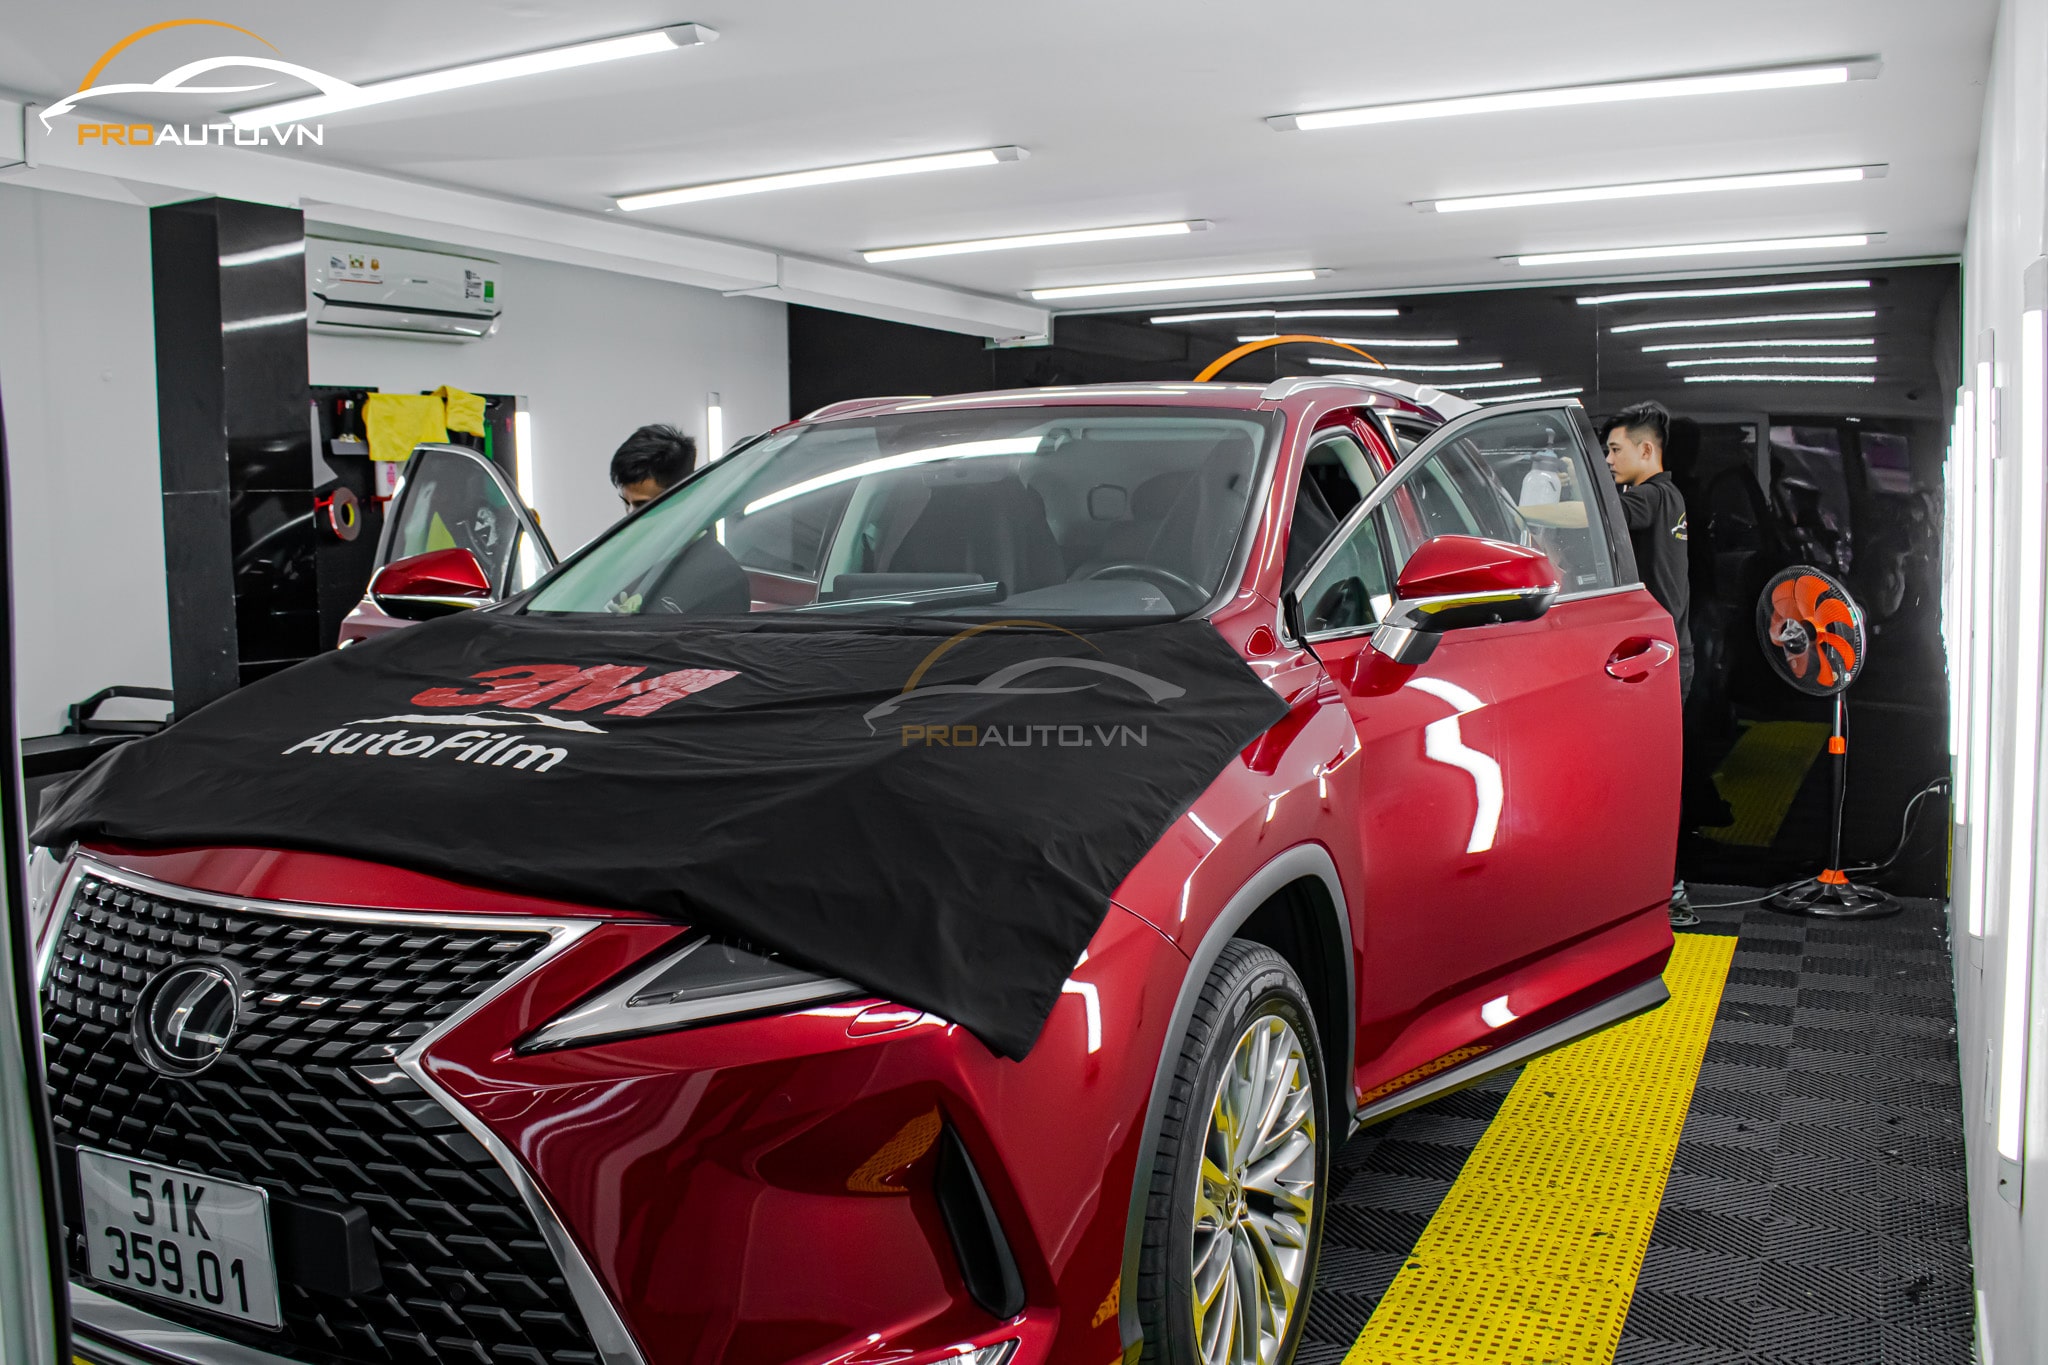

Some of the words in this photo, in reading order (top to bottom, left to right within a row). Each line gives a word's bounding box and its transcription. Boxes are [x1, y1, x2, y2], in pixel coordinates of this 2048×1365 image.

[410, 663, 741, 717] 3M
[281, 728, 569, 773] AutoFilm
[129, 1169, 212, 1241] 51K
[104, 1226, 249, 1313] 359.01
